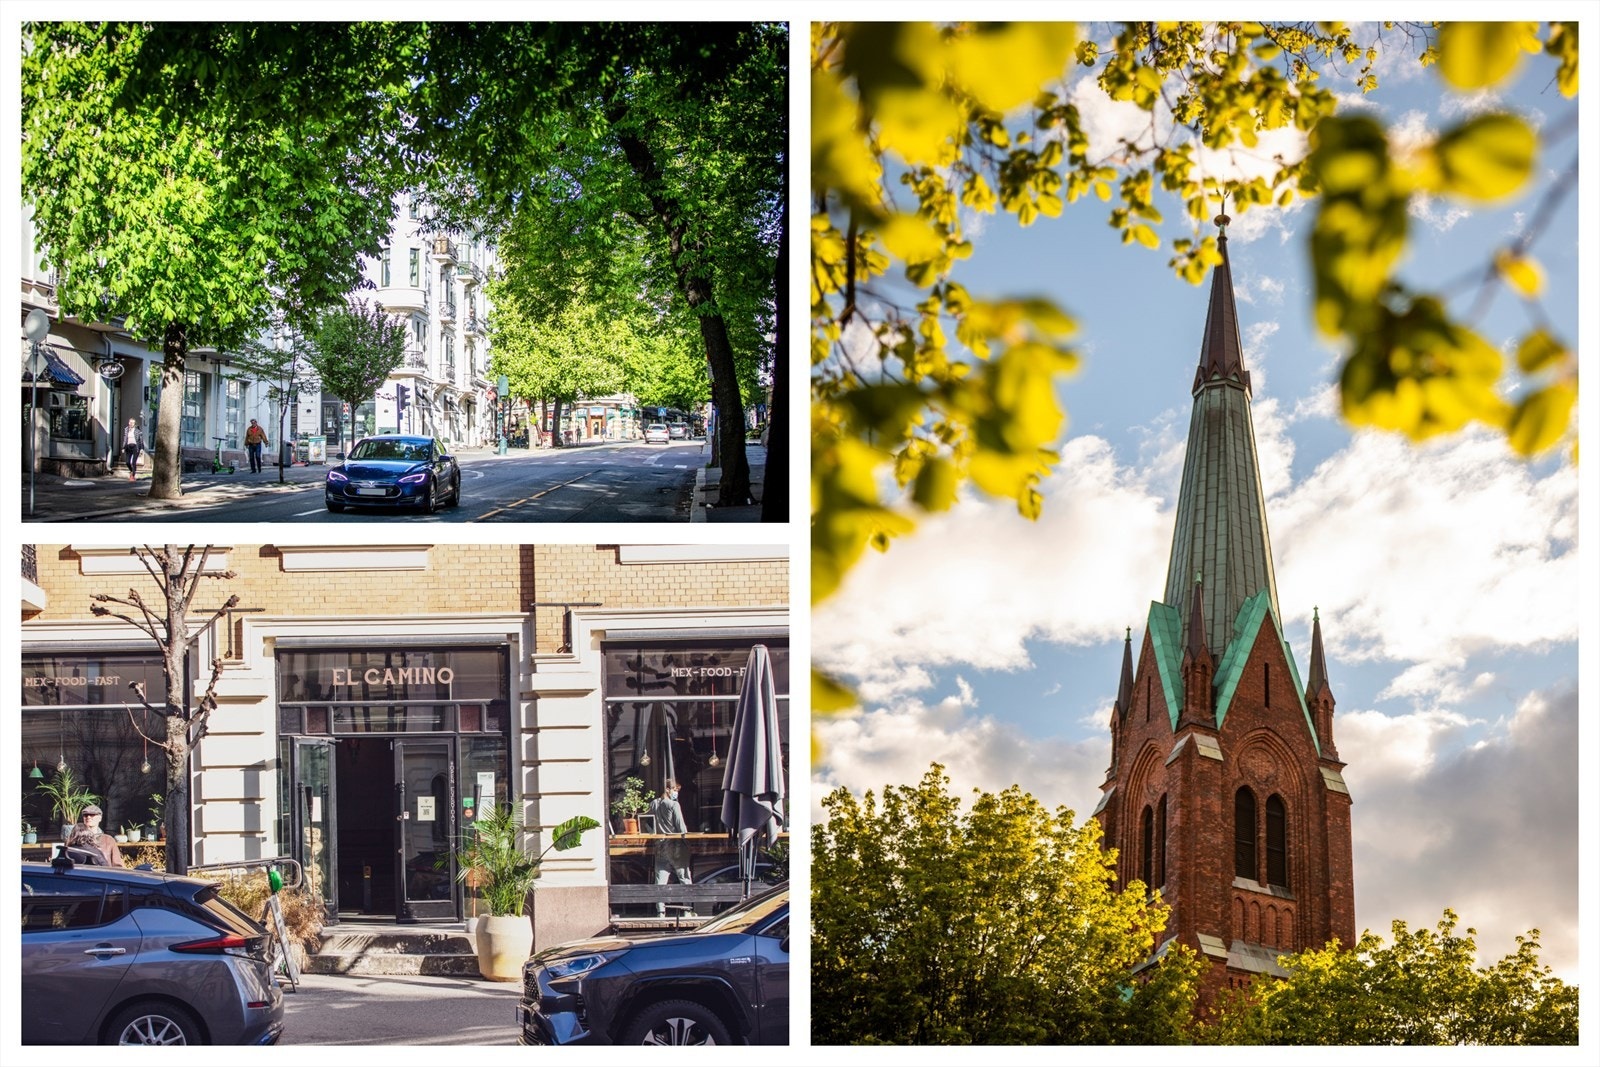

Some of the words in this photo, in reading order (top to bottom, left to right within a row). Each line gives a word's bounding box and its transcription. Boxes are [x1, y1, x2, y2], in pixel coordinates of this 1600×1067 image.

[332, 669, 359, 686] EL
[364, 667, 454, 685] CAMINO
[671, 667, 746, 677] MEX-FOOD-F
[25, 676, 120, 686] MEX-FOOD-FAST
